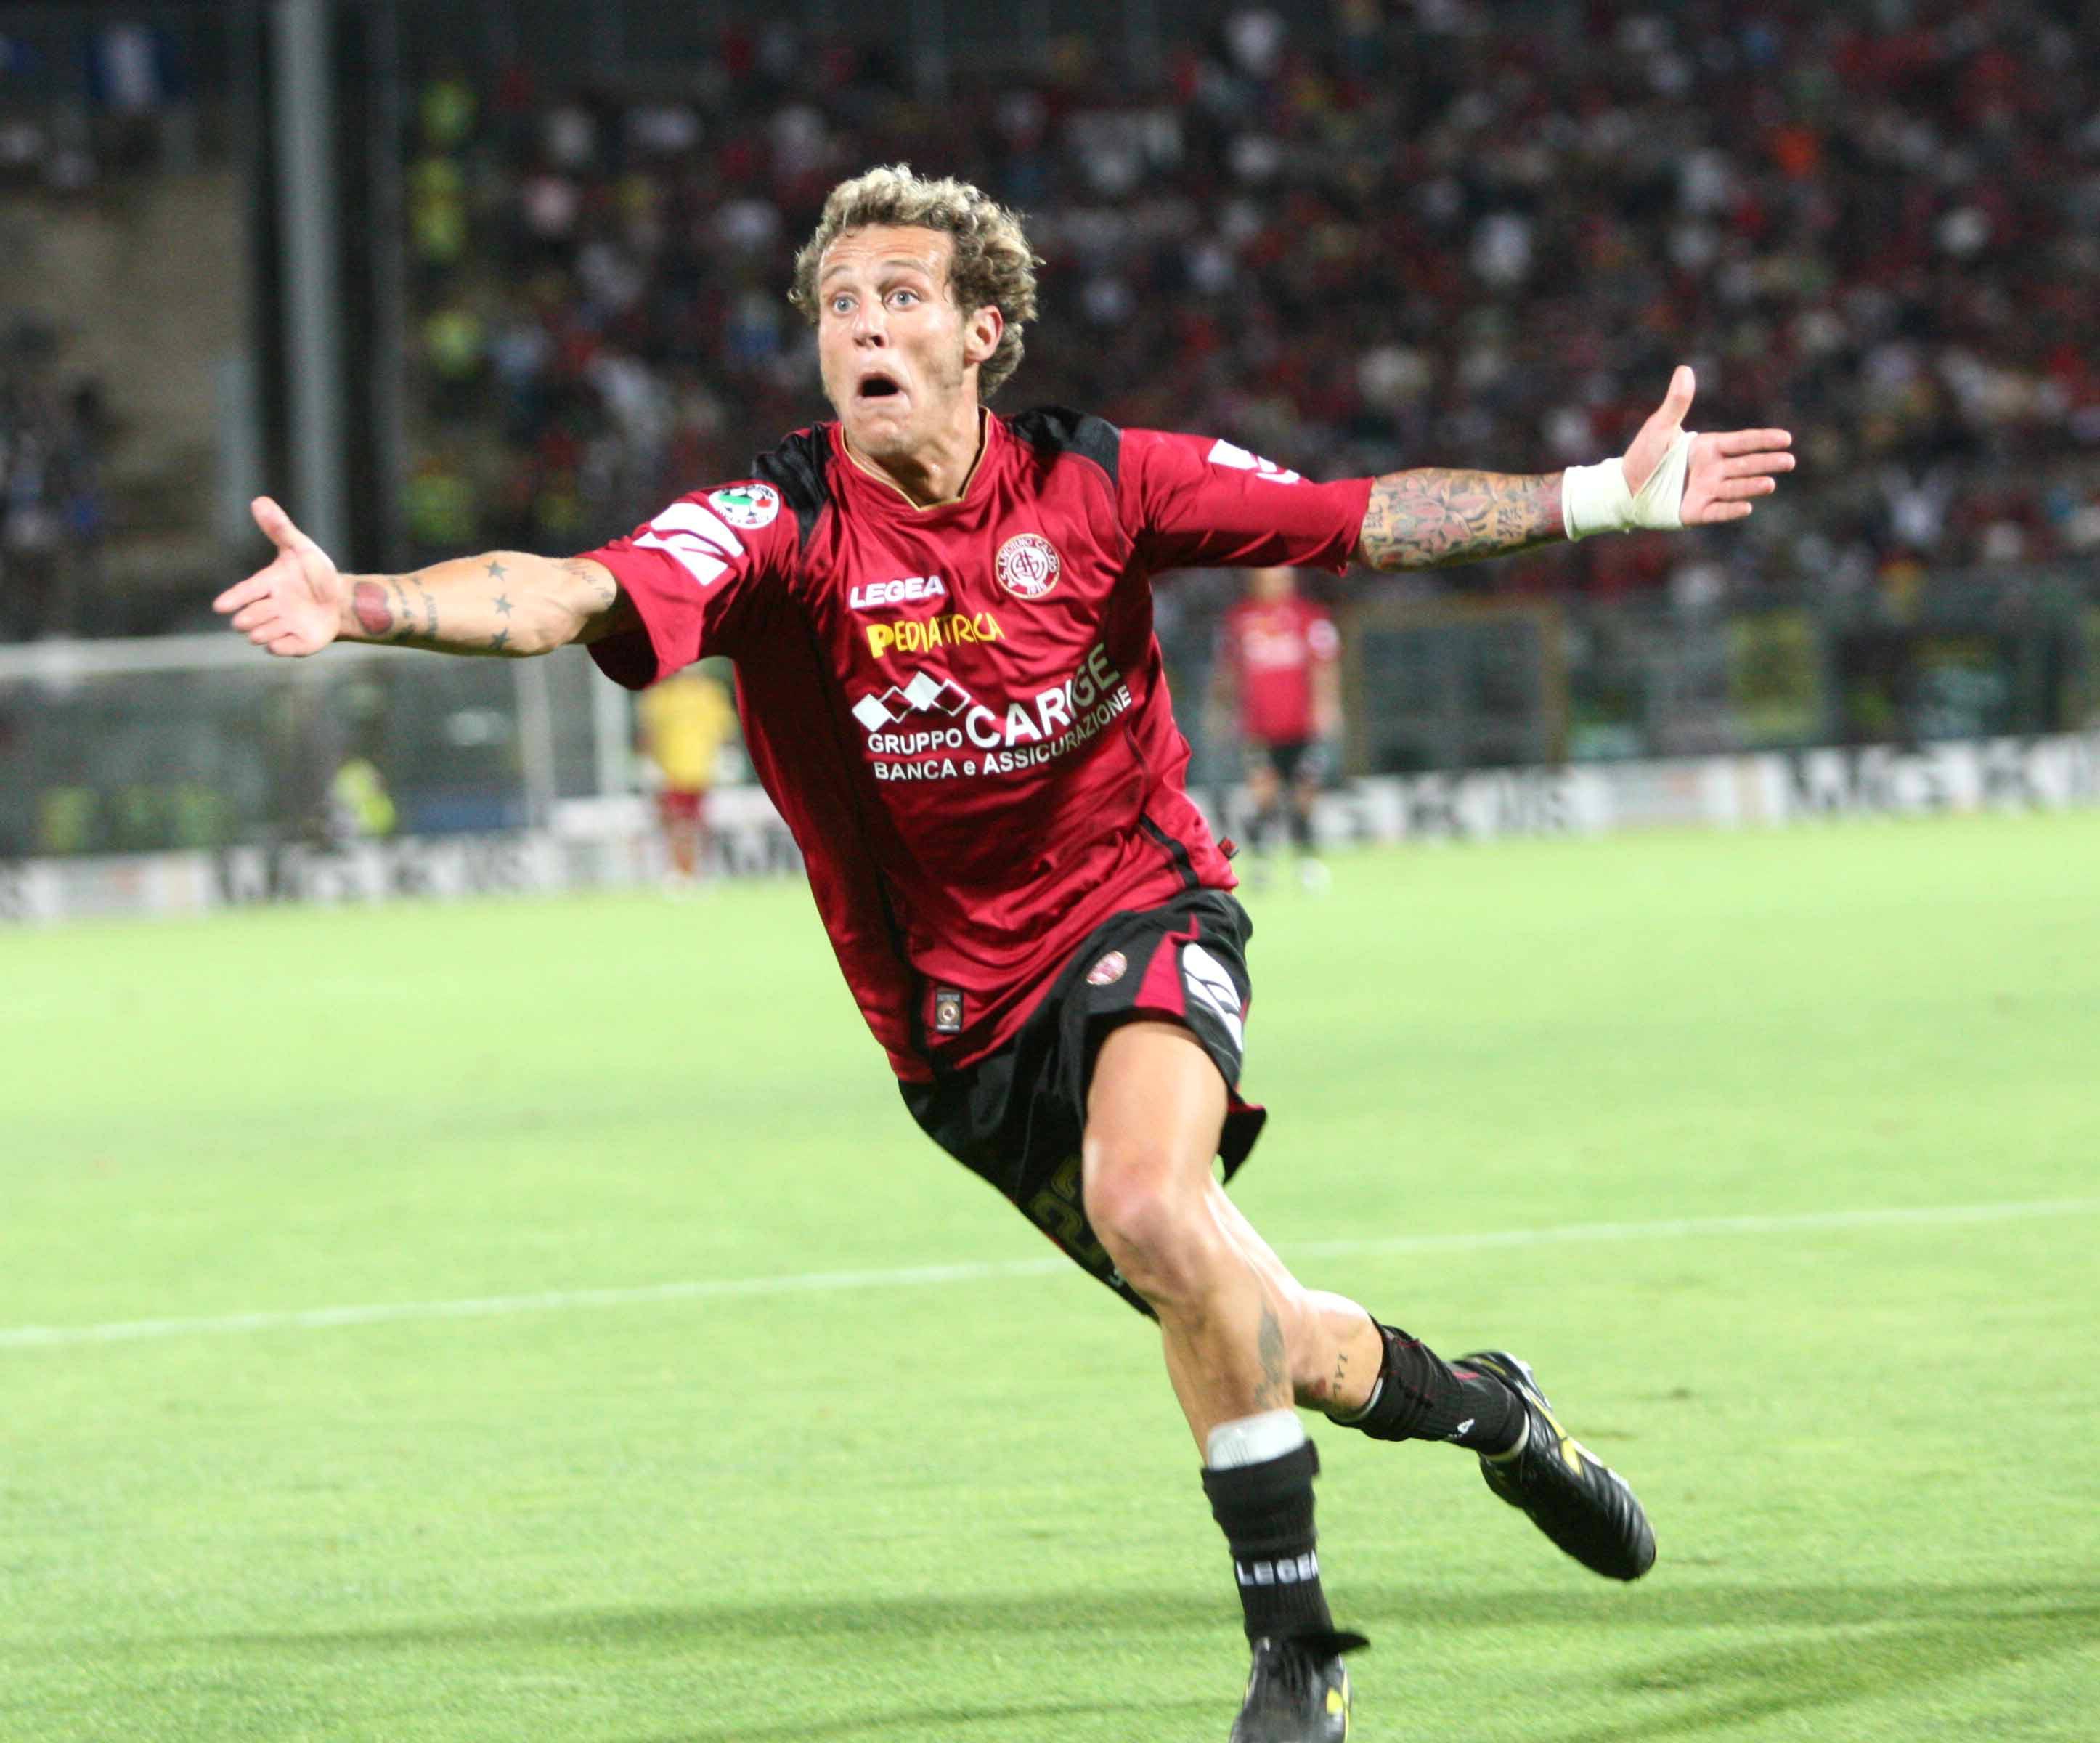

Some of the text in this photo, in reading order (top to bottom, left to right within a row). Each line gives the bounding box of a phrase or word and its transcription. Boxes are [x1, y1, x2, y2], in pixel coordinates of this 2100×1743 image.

[850, 575, 945, 609] LEGEA
[866, 612, 1006, 659] PEDIATRICA
[868, 643, 1120, 755] GRUPPO CARIGE
[874, 684, 1132, 781] BANCA e ASSICURAZIONE
